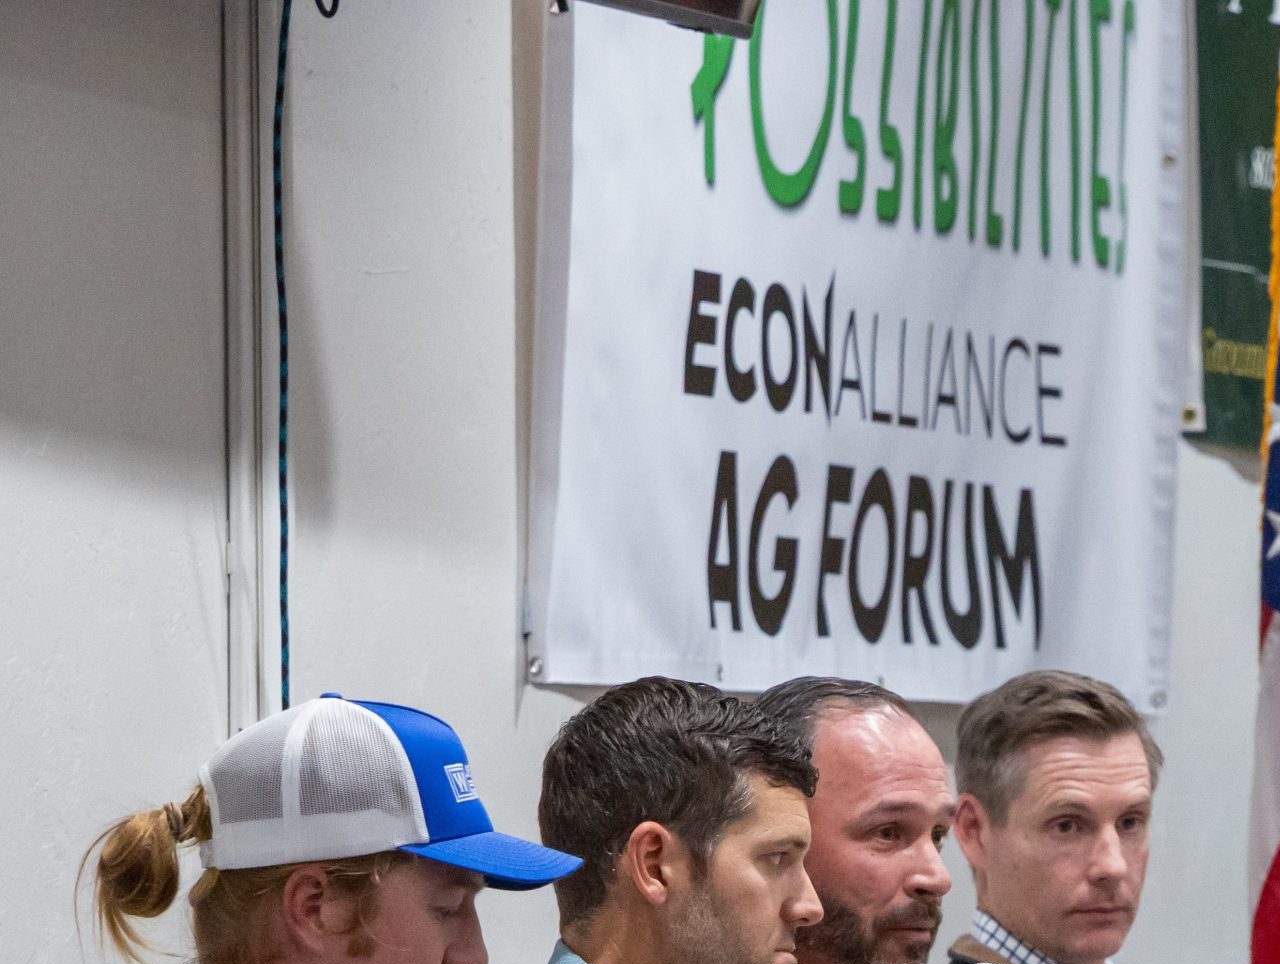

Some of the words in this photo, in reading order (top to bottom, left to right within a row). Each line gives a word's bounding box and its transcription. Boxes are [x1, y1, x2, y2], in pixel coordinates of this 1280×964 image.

[683, 268, 1067, 447] ECONALLIANCE
[707, 451, 799, 637] AG
[816, 463, 1041, 652] FORUM
